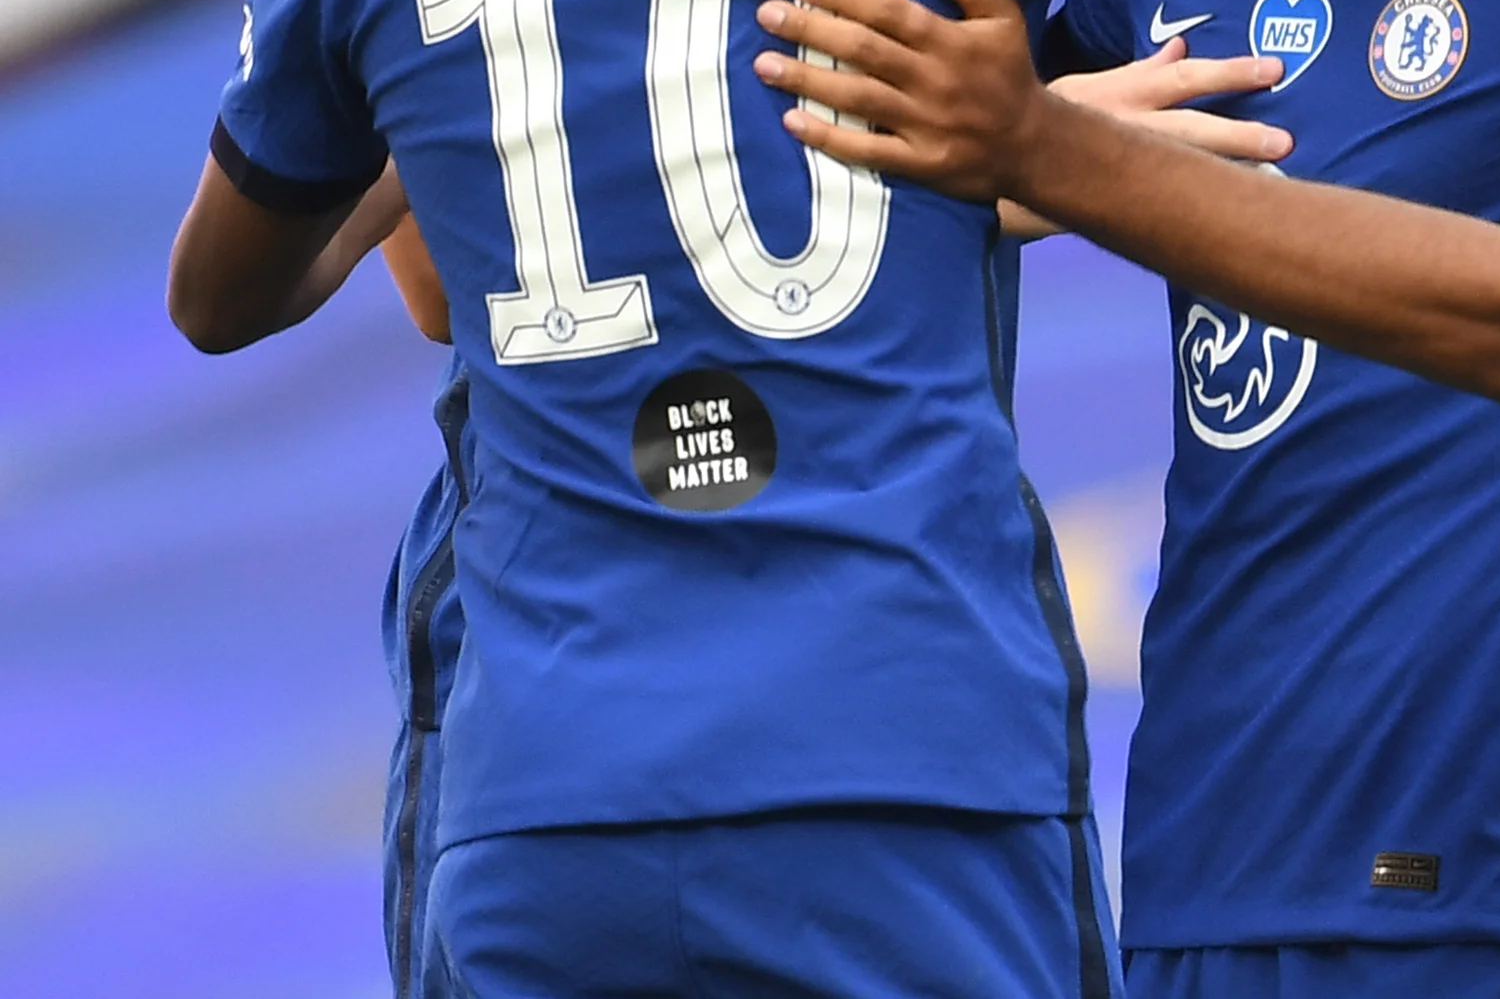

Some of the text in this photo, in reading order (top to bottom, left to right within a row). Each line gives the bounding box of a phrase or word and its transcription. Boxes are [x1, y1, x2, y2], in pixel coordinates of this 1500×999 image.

[1264, 21, 1312, 48] NHS
[676, 428, 734, 459] LIVES
[668, 456, 748, 491] MATTER
